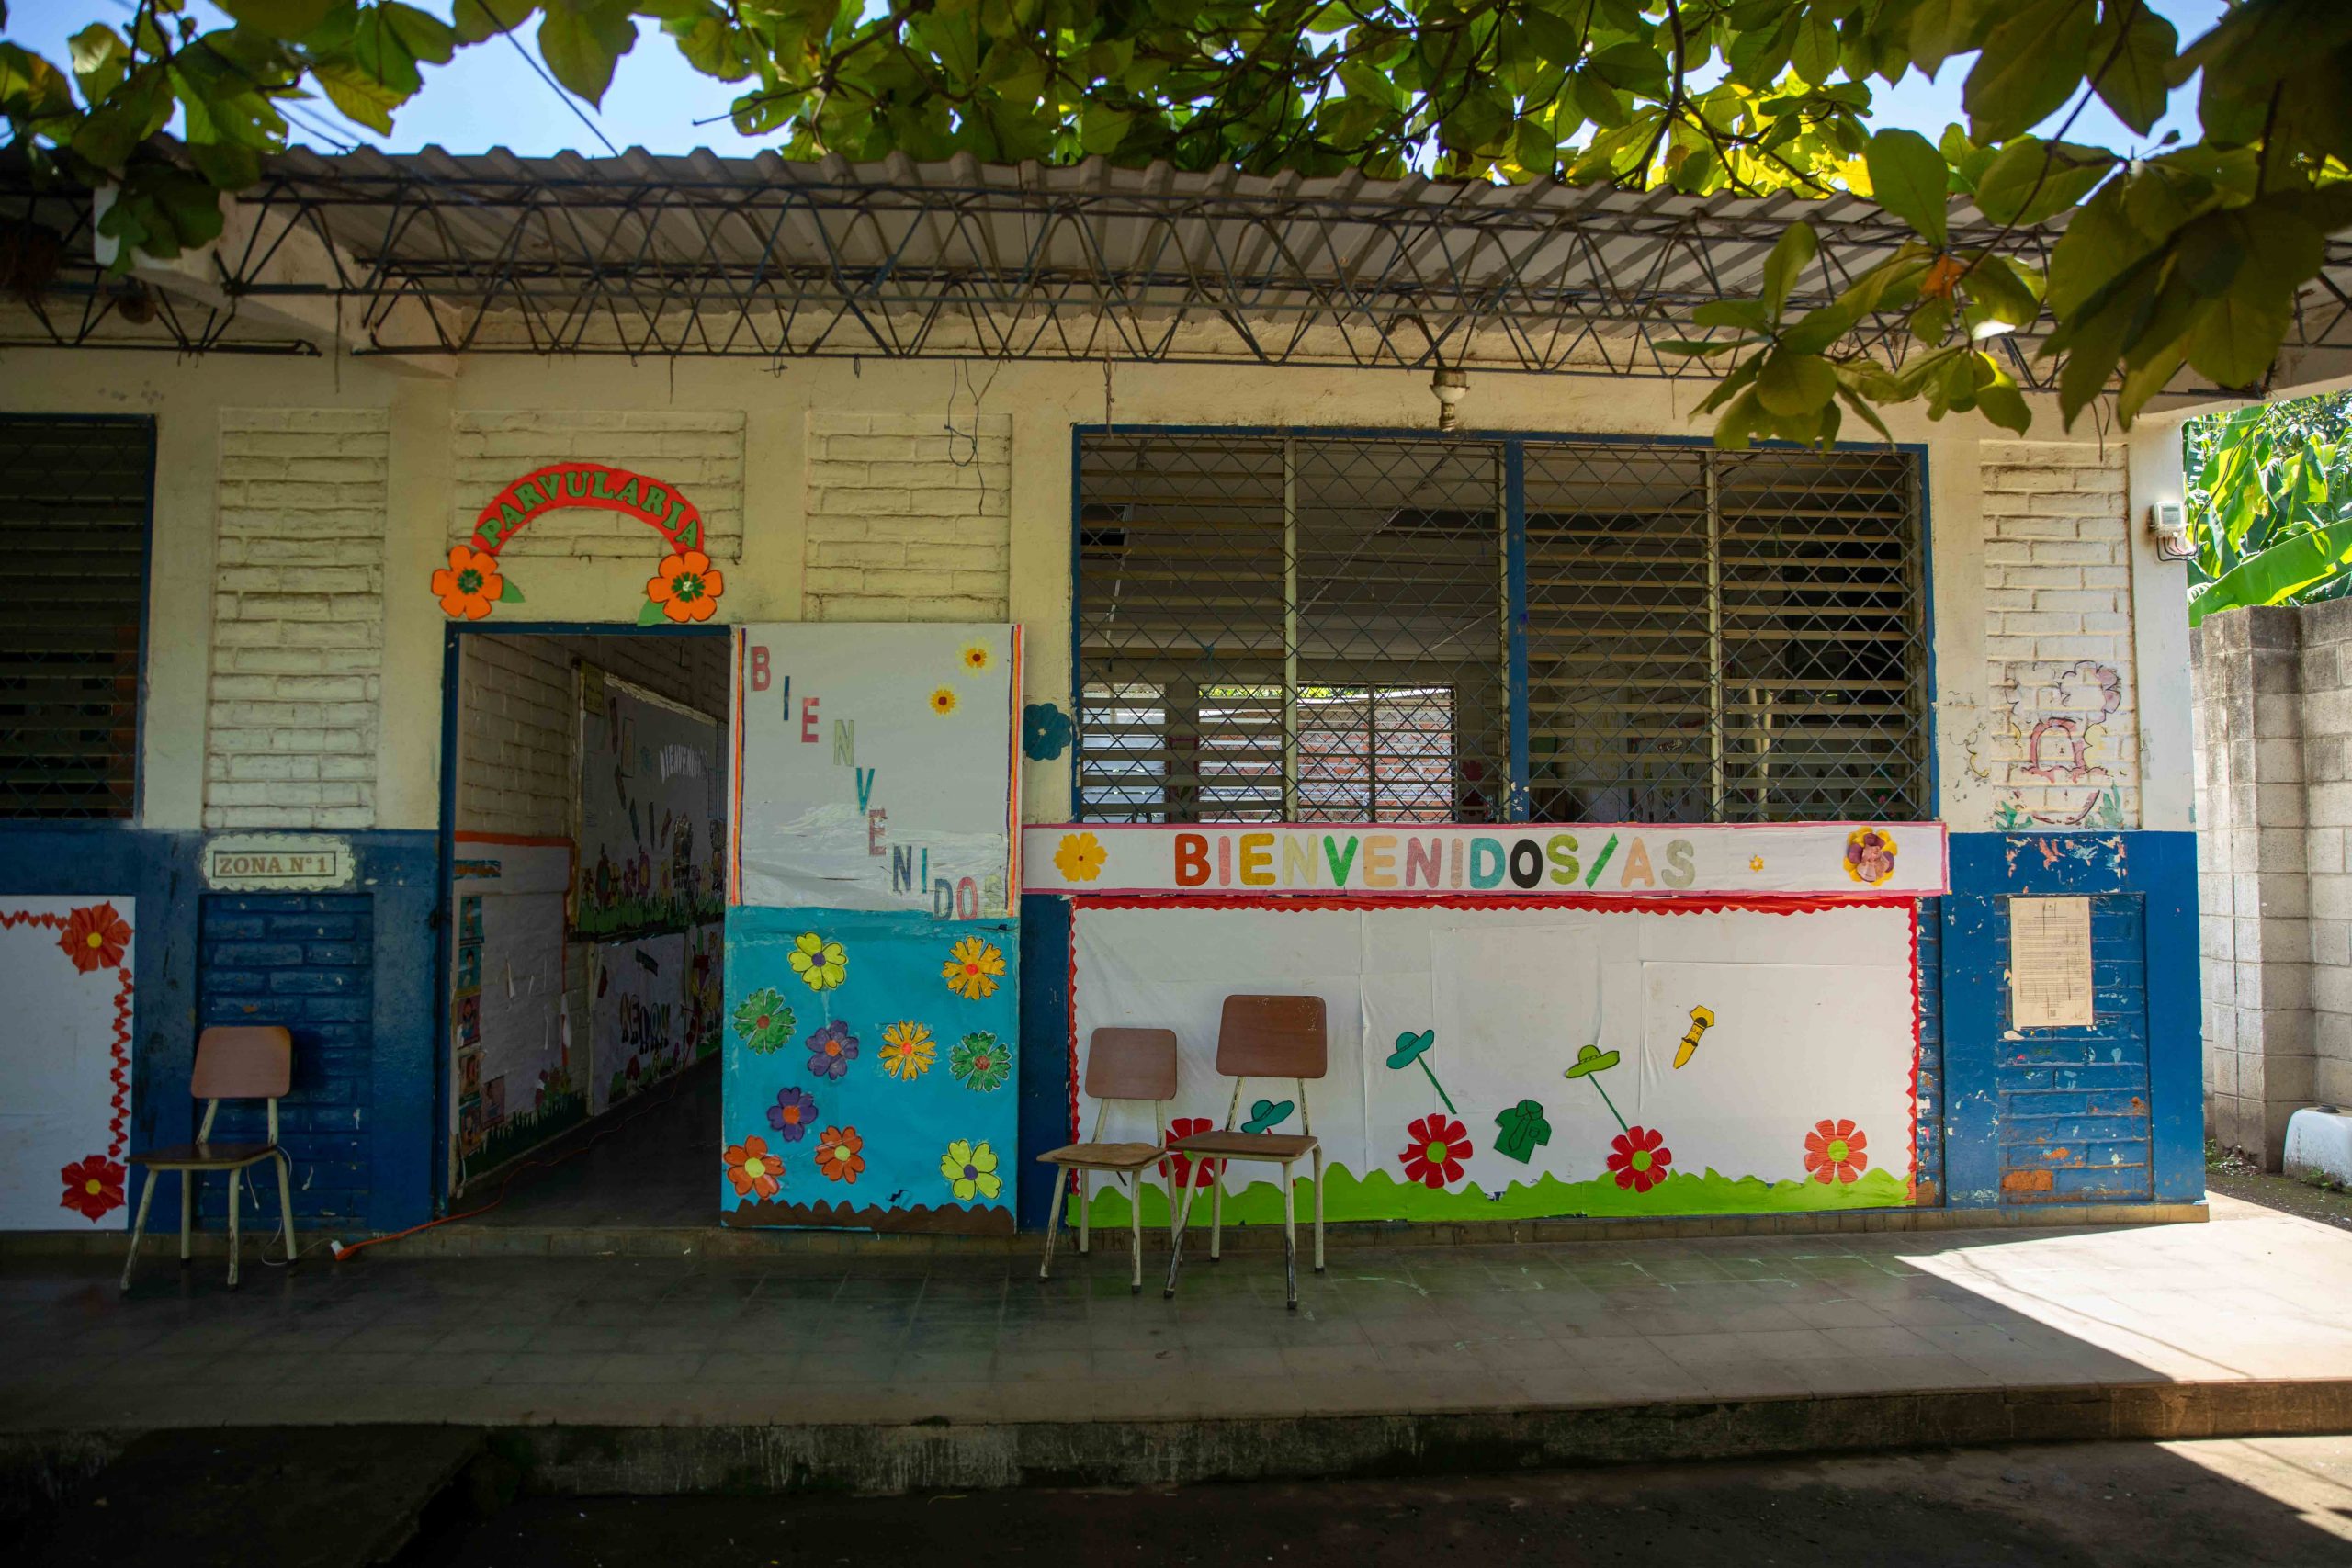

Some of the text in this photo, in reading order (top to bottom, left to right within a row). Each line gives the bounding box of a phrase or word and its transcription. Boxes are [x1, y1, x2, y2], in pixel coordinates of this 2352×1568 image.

[476, 470, 699, 549] PARVULARIA
[220, 856, 283, 874] ZONA
[1174, 832, 1697, 890] BIENVENIDOS/AS
